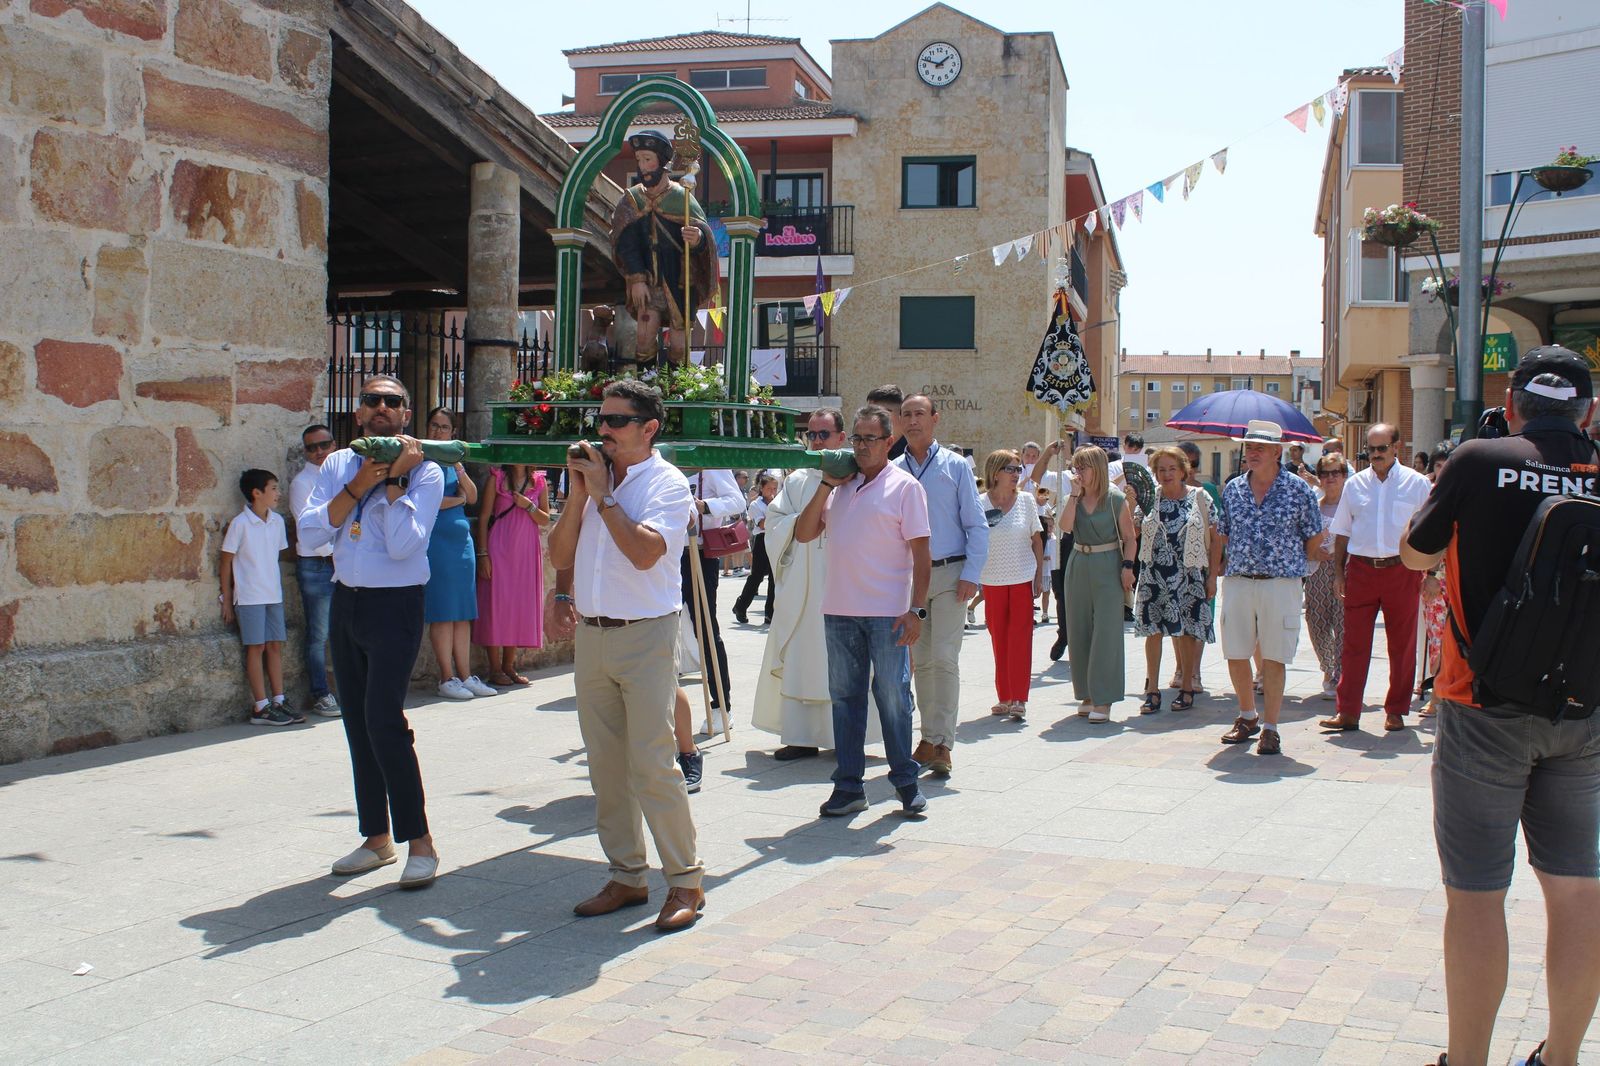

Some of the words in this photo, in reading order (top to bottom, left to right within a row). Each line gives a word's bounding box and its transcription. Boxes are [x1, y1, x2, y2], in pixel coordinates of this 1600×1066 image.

[1045, 374, 1081, 389] Estrella
[922, 384, 956, 396] CASA
[1525, 459, 1571, 473] Salamanca
[1498, 467, 1597, 496] PRENS
